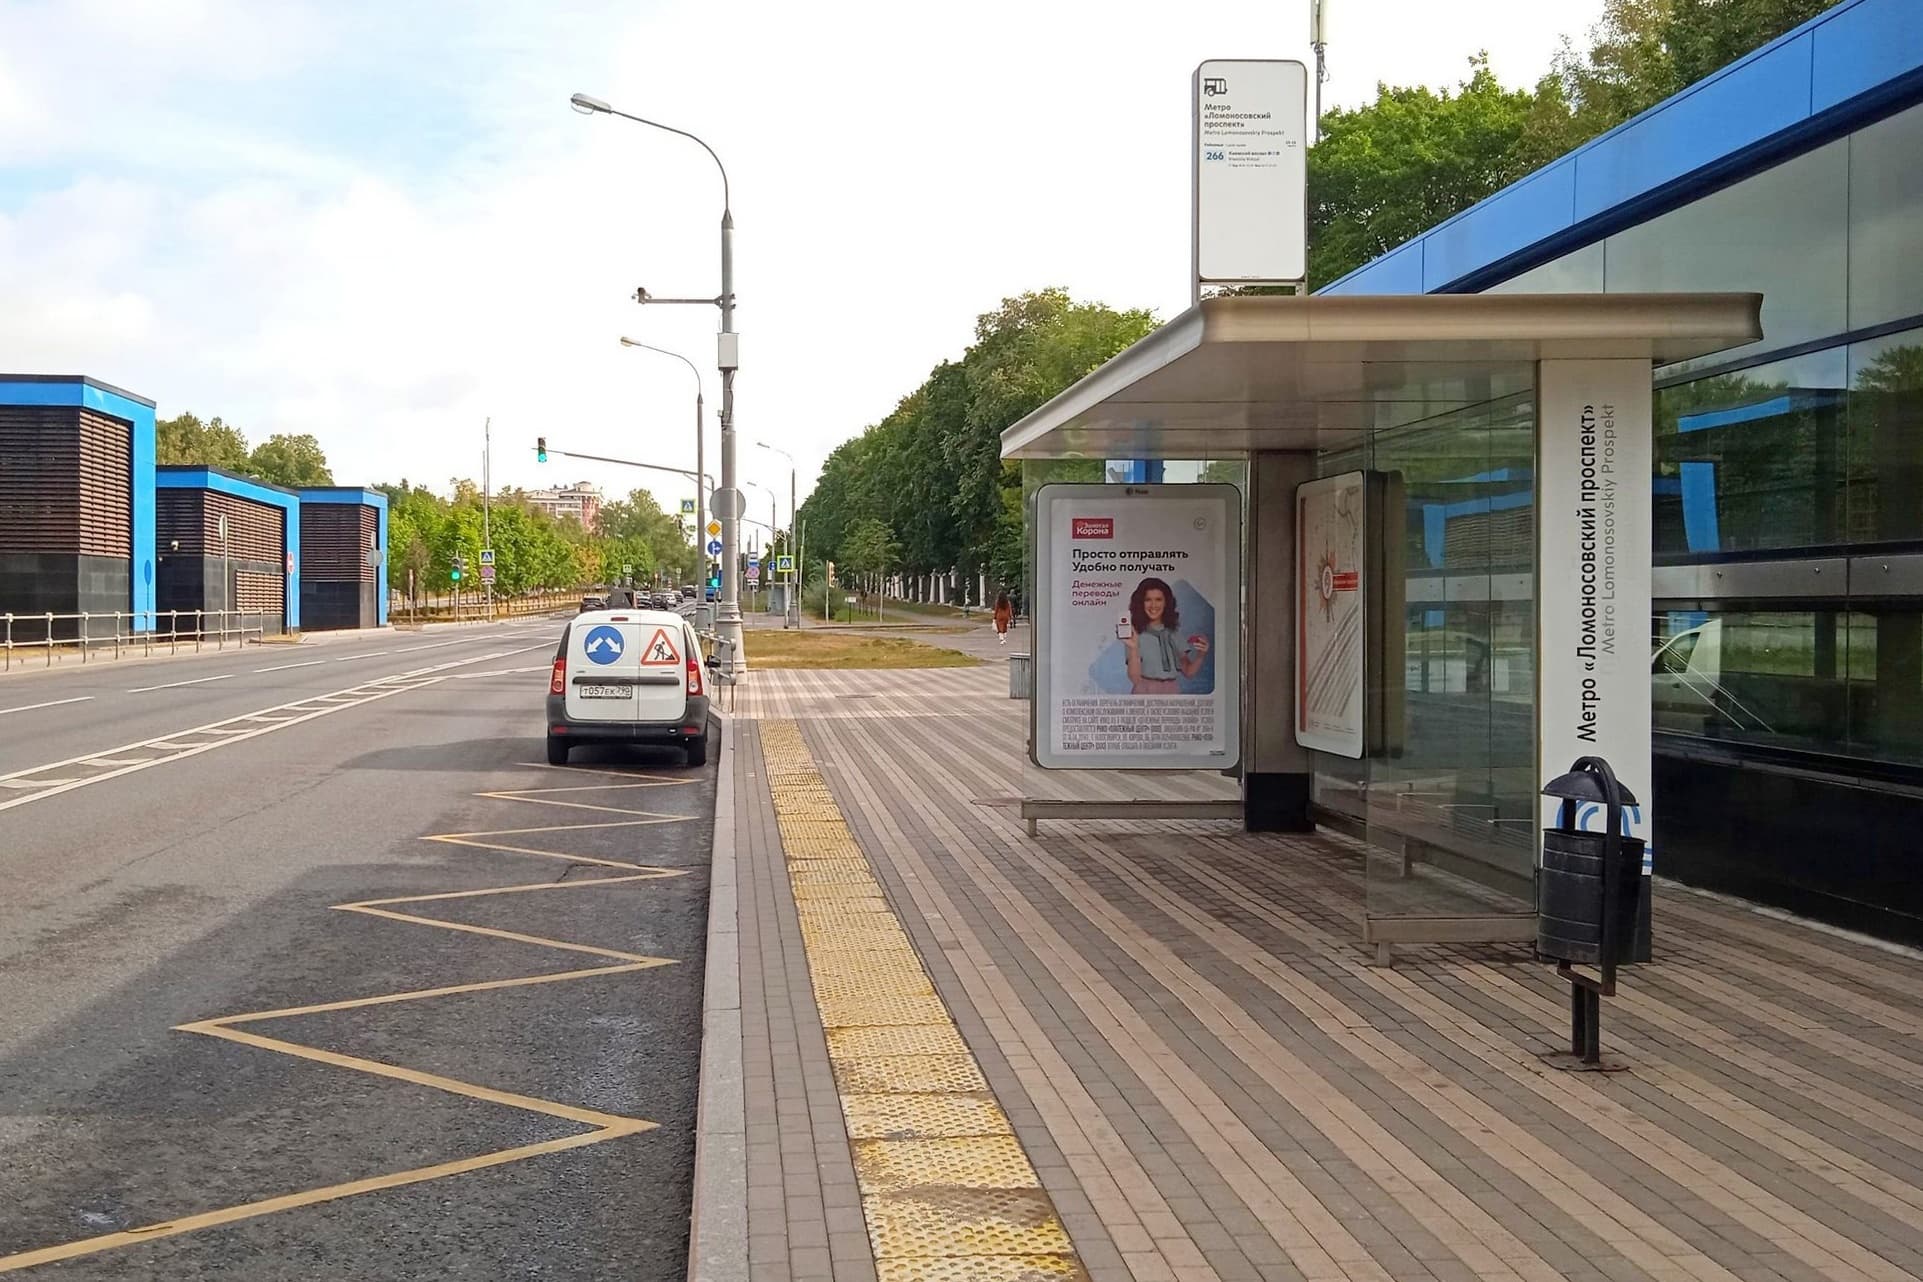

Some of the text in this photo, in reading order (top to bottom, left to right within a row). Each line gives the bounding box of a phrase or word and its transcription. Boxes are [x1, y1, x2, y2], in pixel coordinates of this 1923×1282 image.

[1204, 104, 1231, 112] Метро
[1206, 151, 1224, 161] 266
[1076, 527, 1109, 535] Корона
[1601, 405, 1617, 654] Metro Lomonosovskiy Prospekt
[1072, 549, 1189, 560] Просто отправлять
[1072, 562, 1175, 574] Удобно получать
[1576, 405, 1600, 743] Метро «Ломоносовский проспект»
[1072, 598, 1107, 606] онлайн
